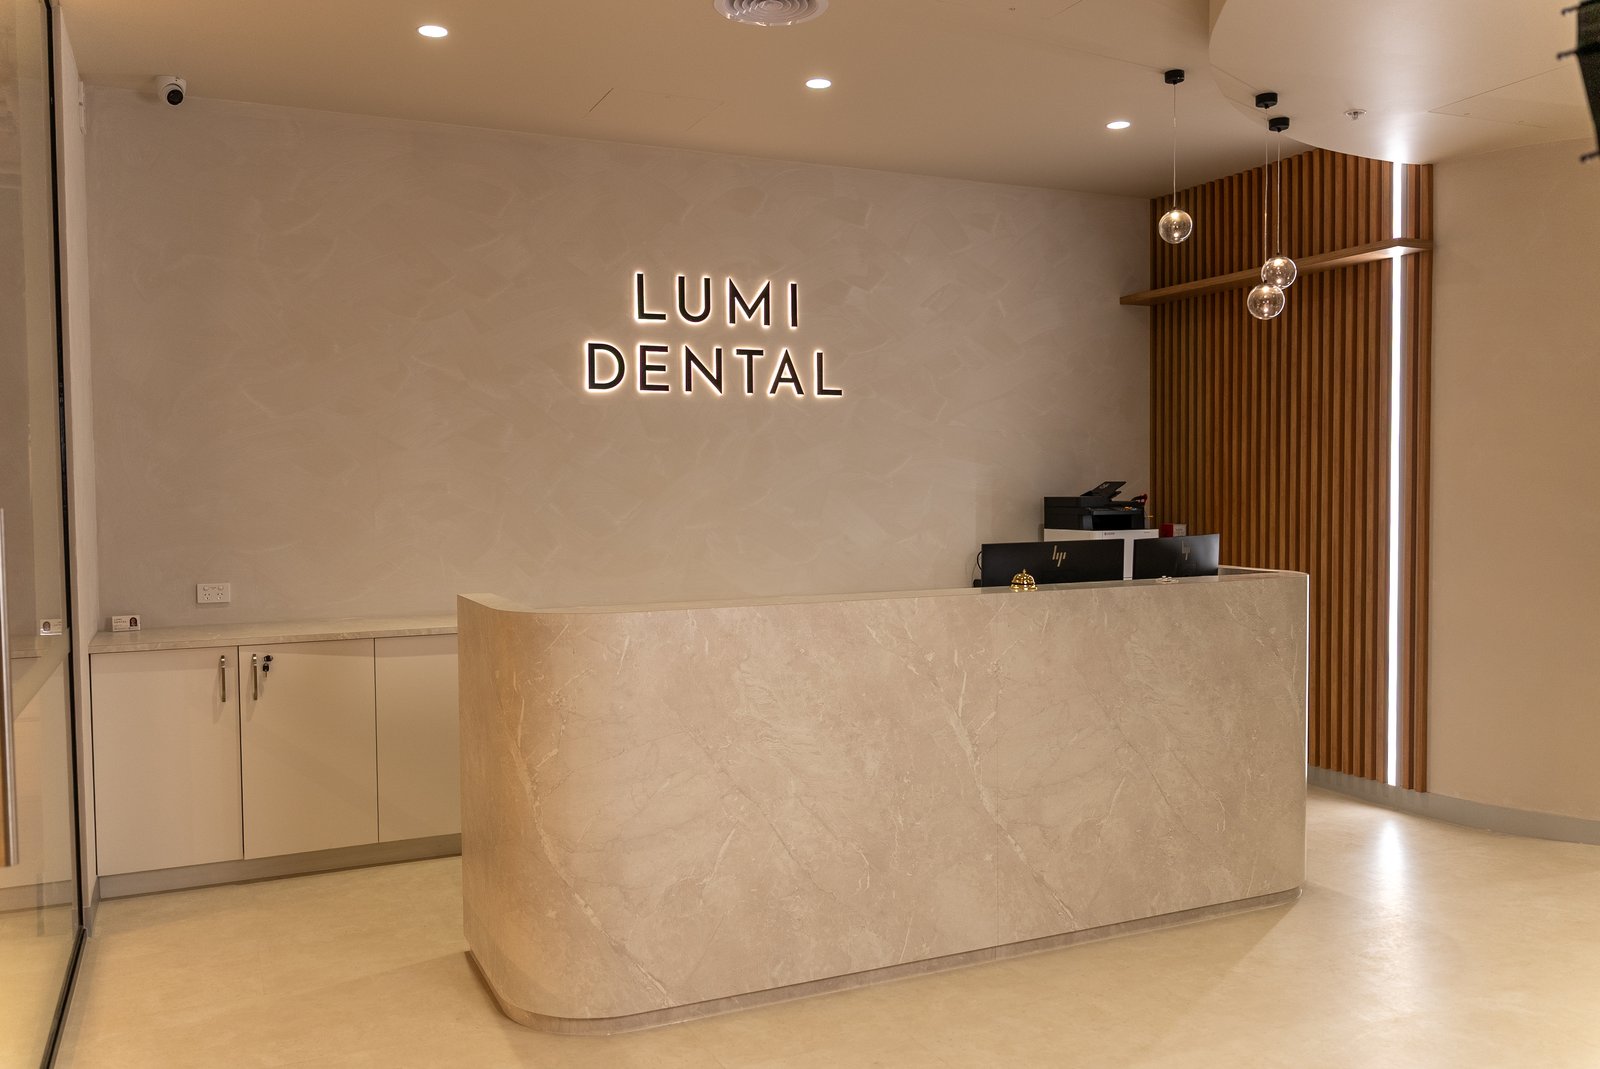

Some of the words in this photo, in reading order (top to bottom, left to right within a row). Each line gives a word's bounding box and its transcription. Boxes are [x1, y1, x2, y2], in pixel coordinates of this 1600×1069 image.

[636, 273, 798, 328] LUMI
[587, 342, 843, 396] DENTAL
[1052, 545, 1067, 567] hp
